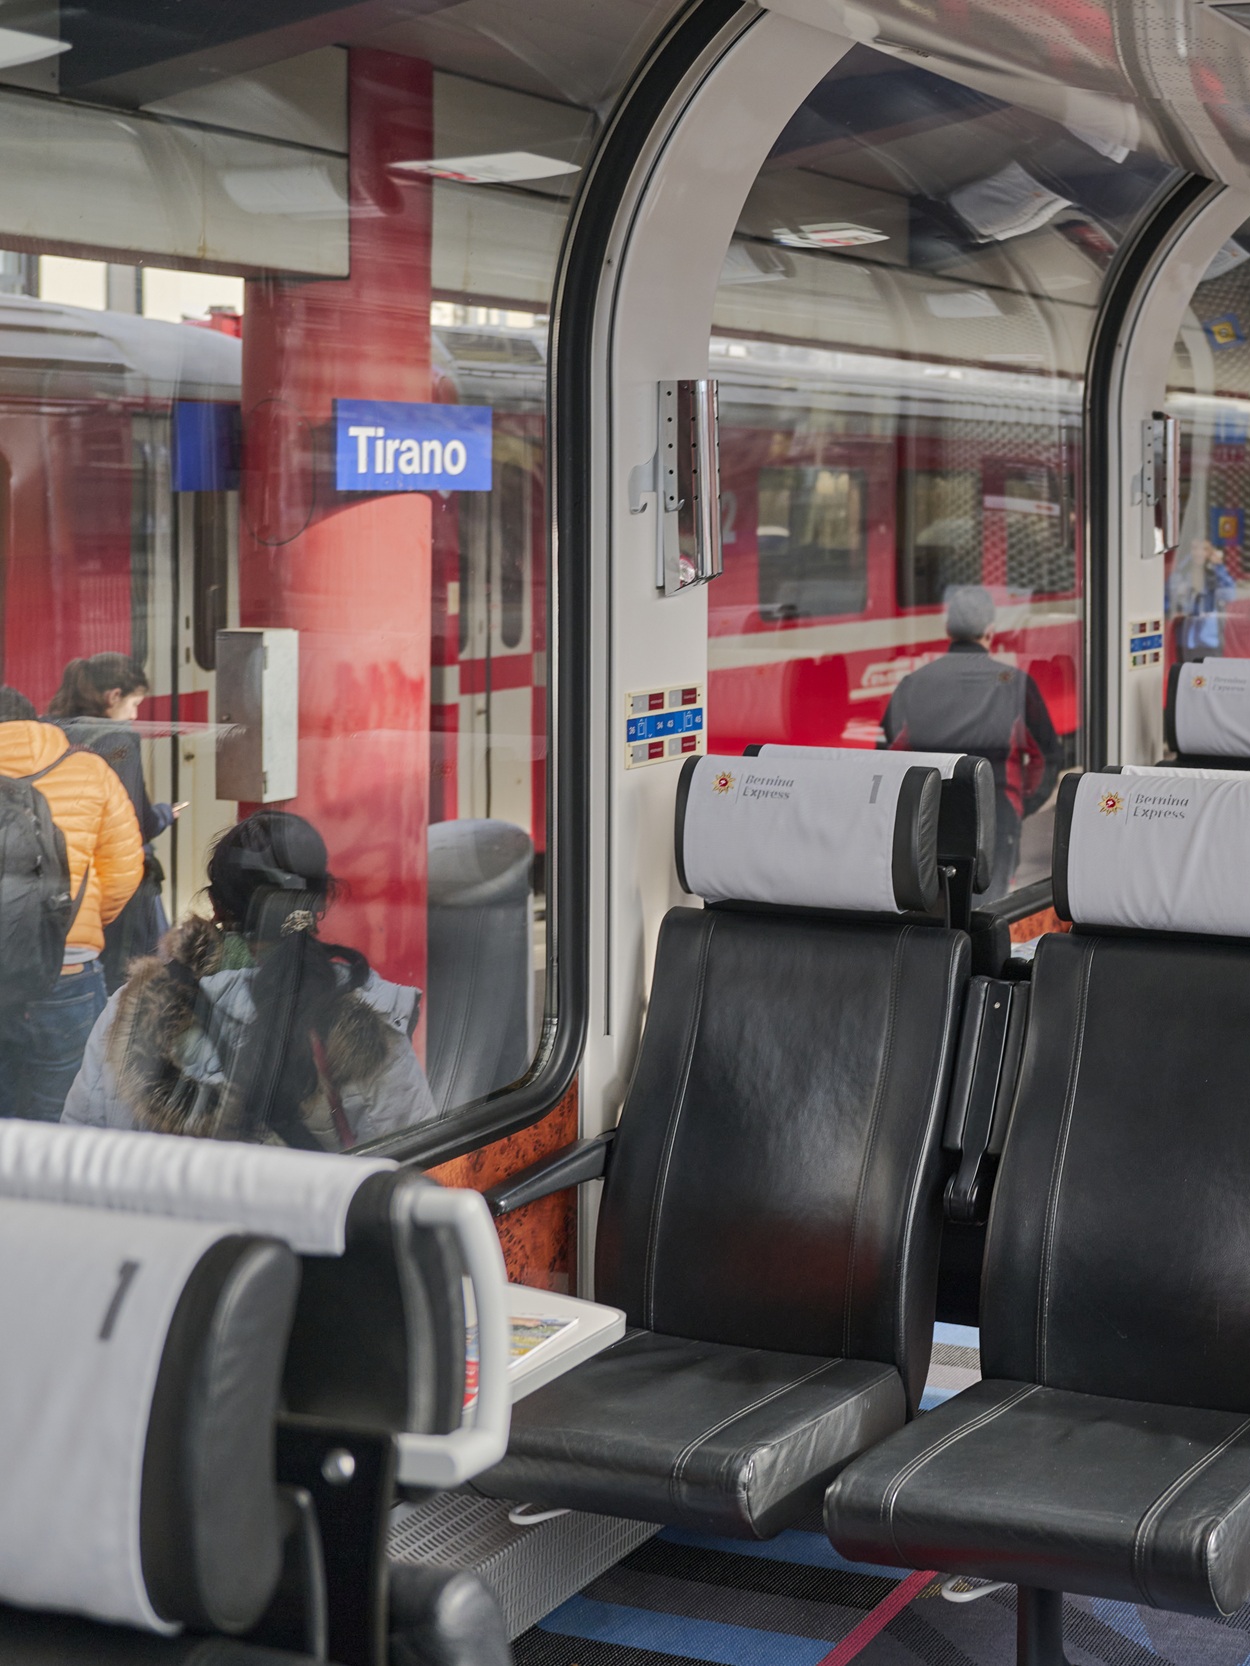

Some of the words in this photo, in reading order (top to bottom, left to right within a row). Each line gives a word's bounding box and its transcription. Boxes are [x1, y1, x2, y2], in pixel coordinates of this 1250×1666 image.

[348, 425, 467, 476] Tirano
[745, 774, 794, 788] Bernina
[742, 786, 791, 801] Express
[868, 774, 883, 804] 1
[1135, 793, 1190, 808] Bernina
[1132, 805, 1186, 820] Express
[97, 1260, 141, 1341] 1
